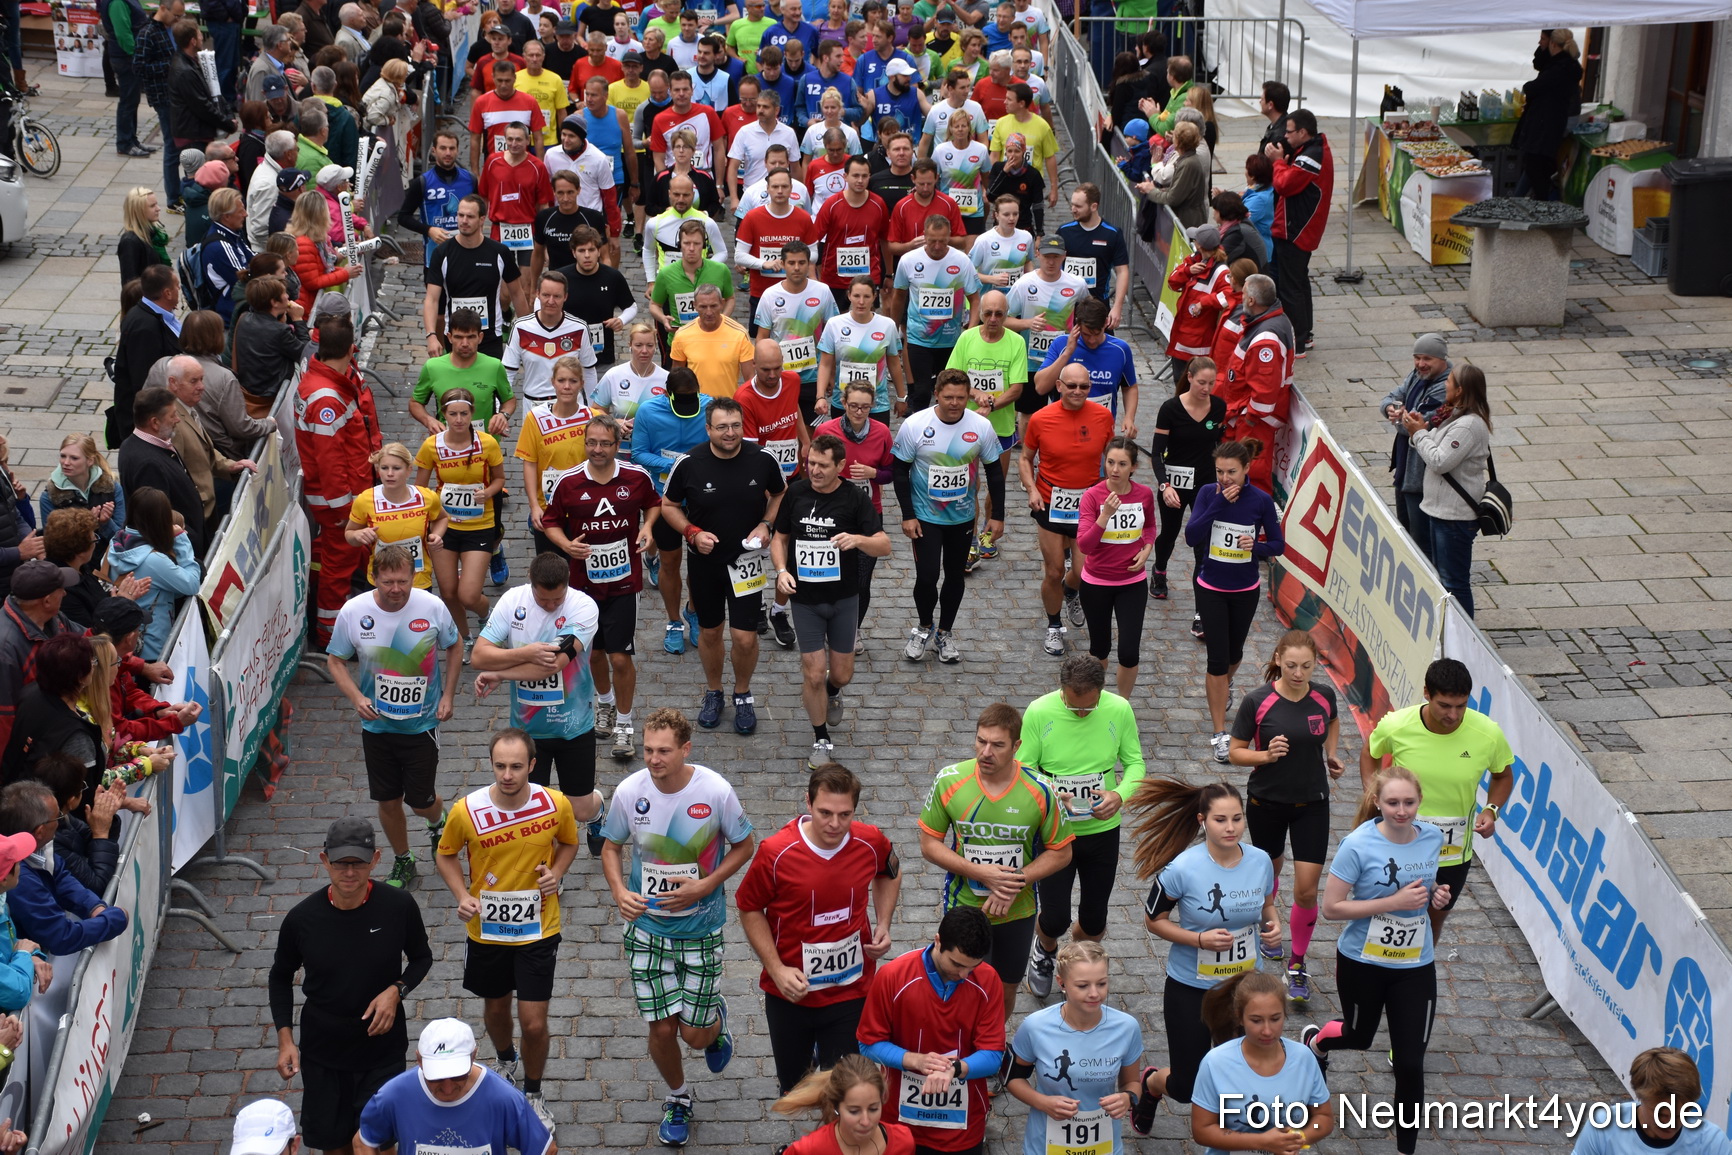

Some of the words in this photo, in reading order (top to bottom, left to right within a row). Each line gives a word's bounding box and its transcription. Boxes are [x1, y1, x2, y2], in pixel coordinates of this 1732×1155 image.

[771, 35, 787, 45] 60
[868, 63, 877, 73] 5
[806, 84, 821, 95] 12
[877, 104, 891, 114] 13
[427, 187, 446, 200] 22
[955, 195, 973, 206] 273
[344, 210, 355, 233] BMW
[504, 228, 530, 240] 2408
[840, 254, 867, 266] 2361
[1067, 264, 1093, 276] 2510
[922, 295, 951, 308] 2729
[787, 345, 810, 361] 104
[847, 370, 869, 380] 105
[973, 378, 996, 391] 296
[759, 413, 794, 434] NEUMARKT
[543, 433, 567, 446] MAX
[440, 461, 460, 470] MAX
[932, 473, 967, 489] 2345
[1055, 496, 1079, 510] 224
[375, 514, 398, 522] MAX
[401, 510, 426, 519] BÖGL
[1110, 513, 1136, 530] 182
[582, 518, 630, 531] AREVA
[805, 525, 828, 533] Berlin
[590, 549, 627, 569] 3069
[799, 551, 836, 566] 2179
[1218, 549, 1244, 559] Susanne
[591, 566, 628, 579] MAREK
[738, 559, 763, 580] 324
[809, 569, 825, 577] Peter
[1327, 568, 1414, 709] PFLASTERSTEINE
[393, 678, 419, 686] Neumarkt
[379, 684, 422, 704] 2086
[531, 693, 544, 701] Jan
[387, 705, 410, 714] Darius
[1071, 778, 1097, 786] Neumarkt
[690, 807, 710, 816] Hervis
[480, 830, 517, 849] MAX
[519, 817, 559, 838] BÖGL
[956, 821, 1030, 841] BOCK
[965, 847, 984, 855] PARTL
[643, 867, 659, 875] PARTL
[1404, 861, 1424, 872] GYM
[1425, 860, 1435, 869] HIP
[481, 894, 500, 902] PARTL
[1229, 889, 1250, 900] GYM
[1251, 887, 1263, 897] HIP
[486, 903, 536, 923] 2824
[1373, 914, 1396, 924] PARTL
[1396, 918, 1420, 927] Neumarkt
[498, 925, 524, 935] Stefan
[1379, 925, 1418, 947] 337
[826, 939, 853, 954] Neumarkt
[1382, 948, 1406, 959] Katrin
[810, 944, 857, 976] 2407
[1213, 964, 1244, 975] Antonia
[1079, 1058, 1102, 1068] GYM
[903, 1074, 924, 1085] PARTL
[906, 1084, 962, 1108] 2004
[917, 1110, 949, 1121] Florian
[1072, 1114, 1103, 1122] Neumarkt
[1061, 1123, 1100, 1145] 191
